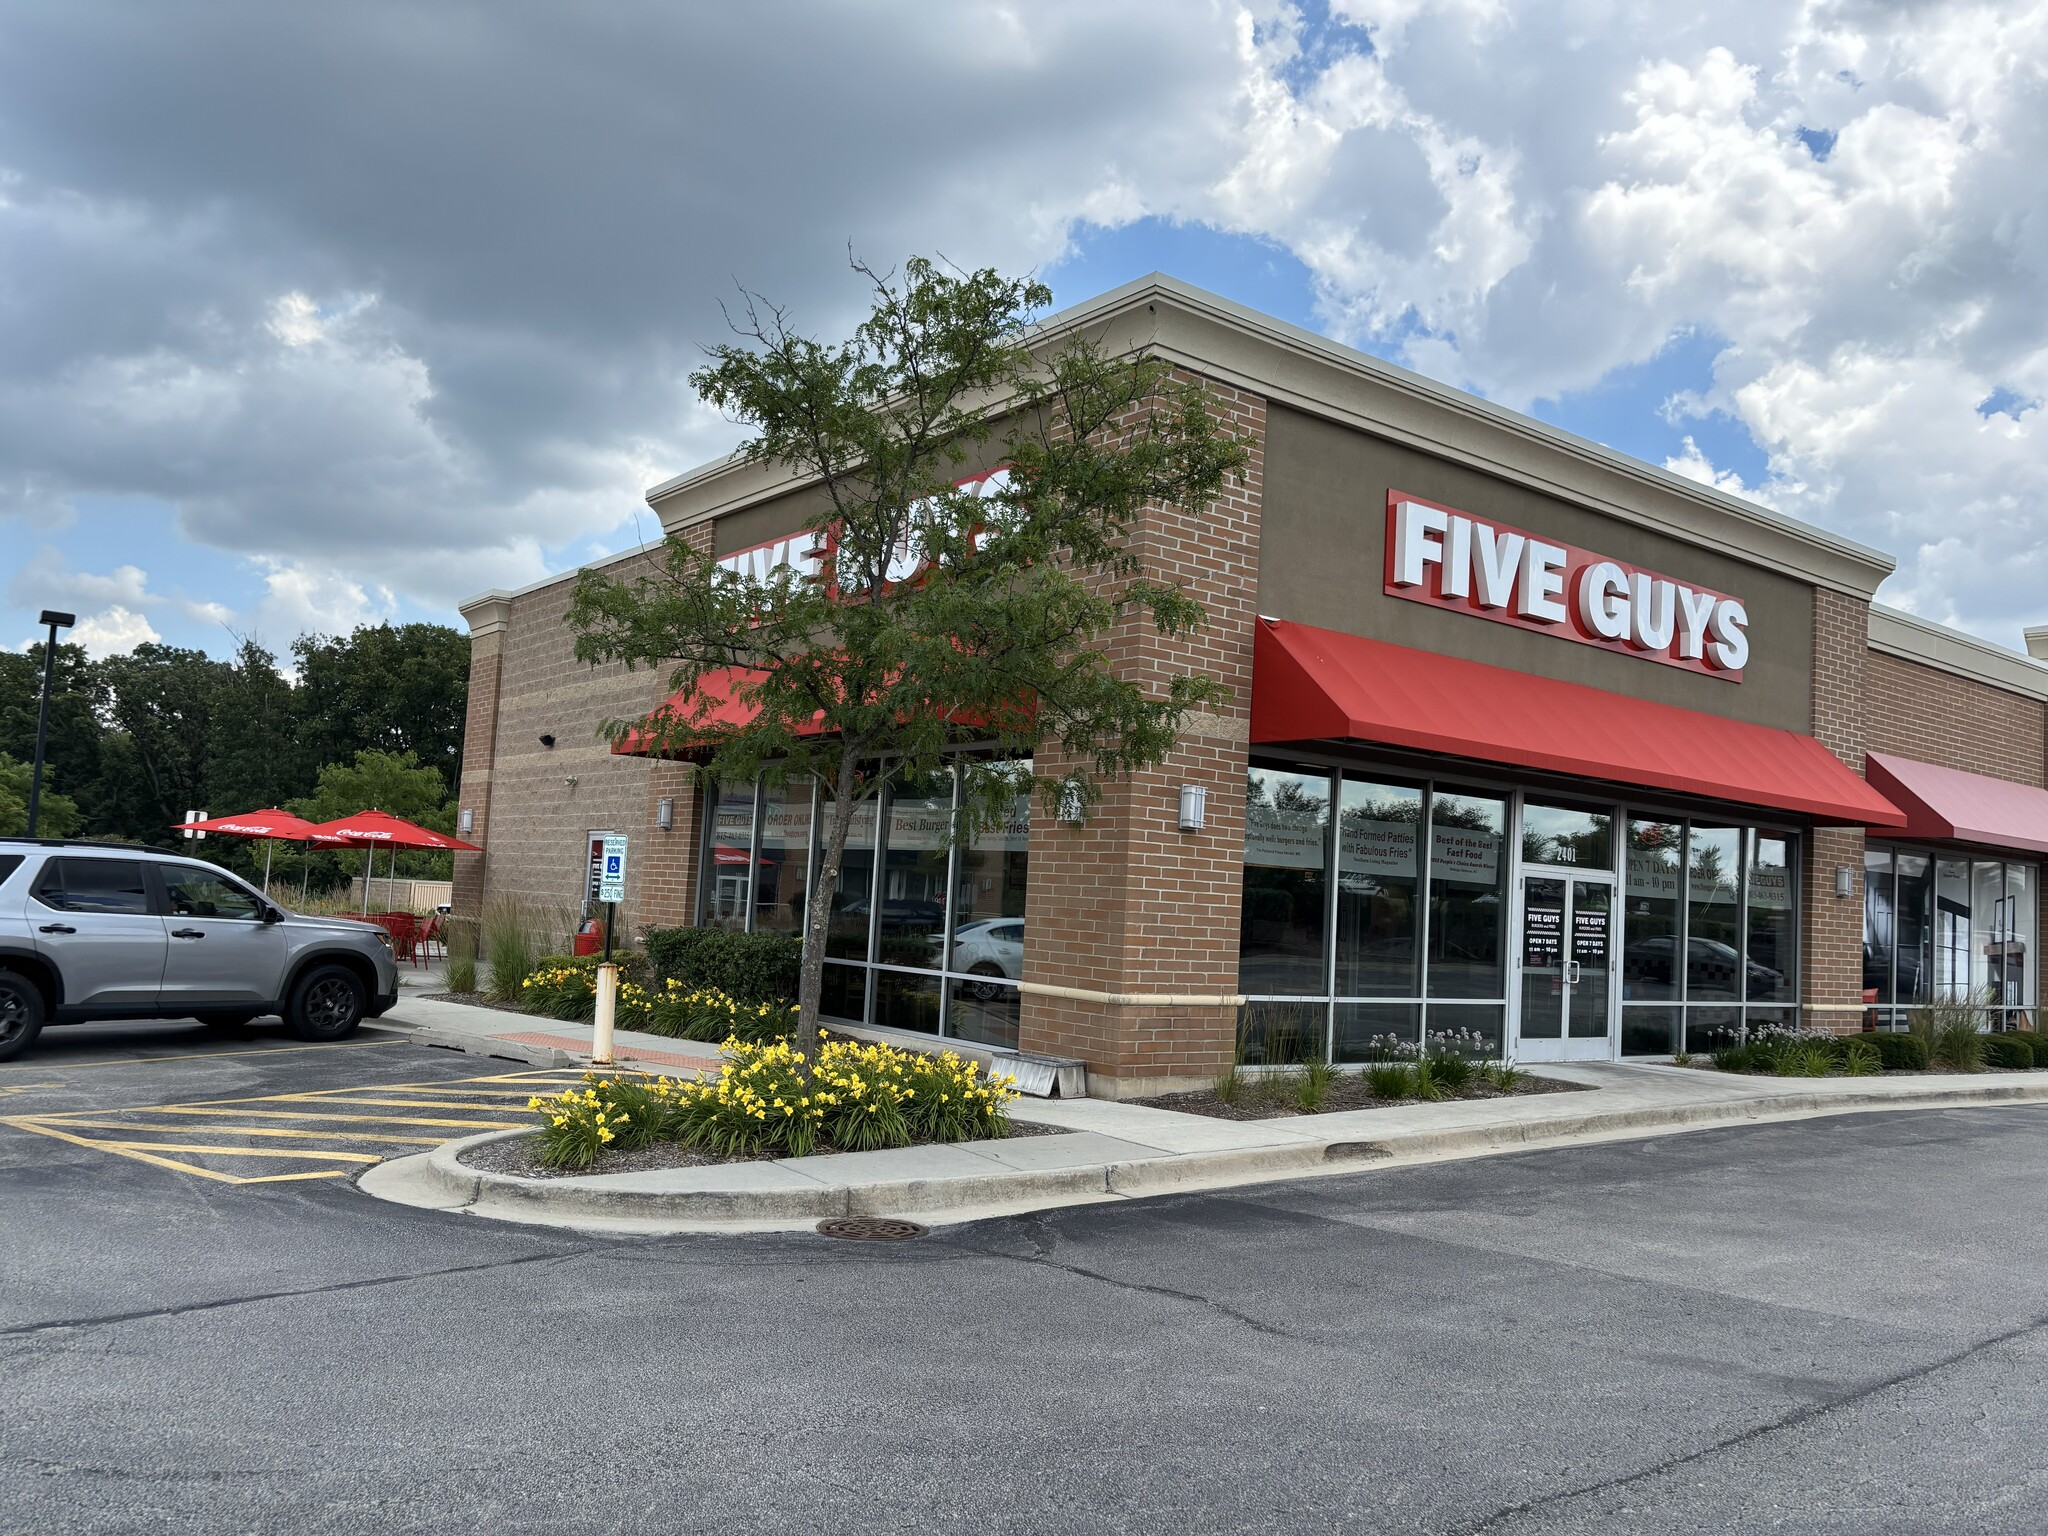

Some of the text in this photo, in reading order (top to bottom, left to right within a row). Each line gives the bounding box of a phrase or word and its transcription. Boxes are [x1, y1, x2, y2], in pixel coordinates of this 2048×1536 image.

[711, 531, 827, 614] FIVE
[1393, 500, 1749, 671] FIVE GUYS
[717, 815, 734, 825] FIVE
[896, 819, 949, 833] Best Burger
[1002, 820, 1030, 834] Fries
[1277, 835, 1295, 846] burgers
[1296, 837, 1305, 846] and
[1360, 829, 1386, 842] Formed
[1387, 831, 1415, 844] Patties
[1435, 834, 1493, 850] Best of the Best
[606, 847, 624, 855] PARKING
[1342, 842, 1355, 854] with
[1356, 843, 1387, 857] Fabulous
[1446, 847, 1483, 860] Fast Food
[1556, 846, 1577, 863] 2401
[1645, 860, 1650, 873] 7
[1652, 862, 1676, 875] DAYS
[1633, 878, 1645, 888] am
[1652, 876, 1659, 888] 10
[1661, 880, 1675, 892] pm
[1761, 875, 1784, 888] GUYS
[613, 888, 624, 899] FINE
[1528, 914, 1560, 923] FIVE GUYS
